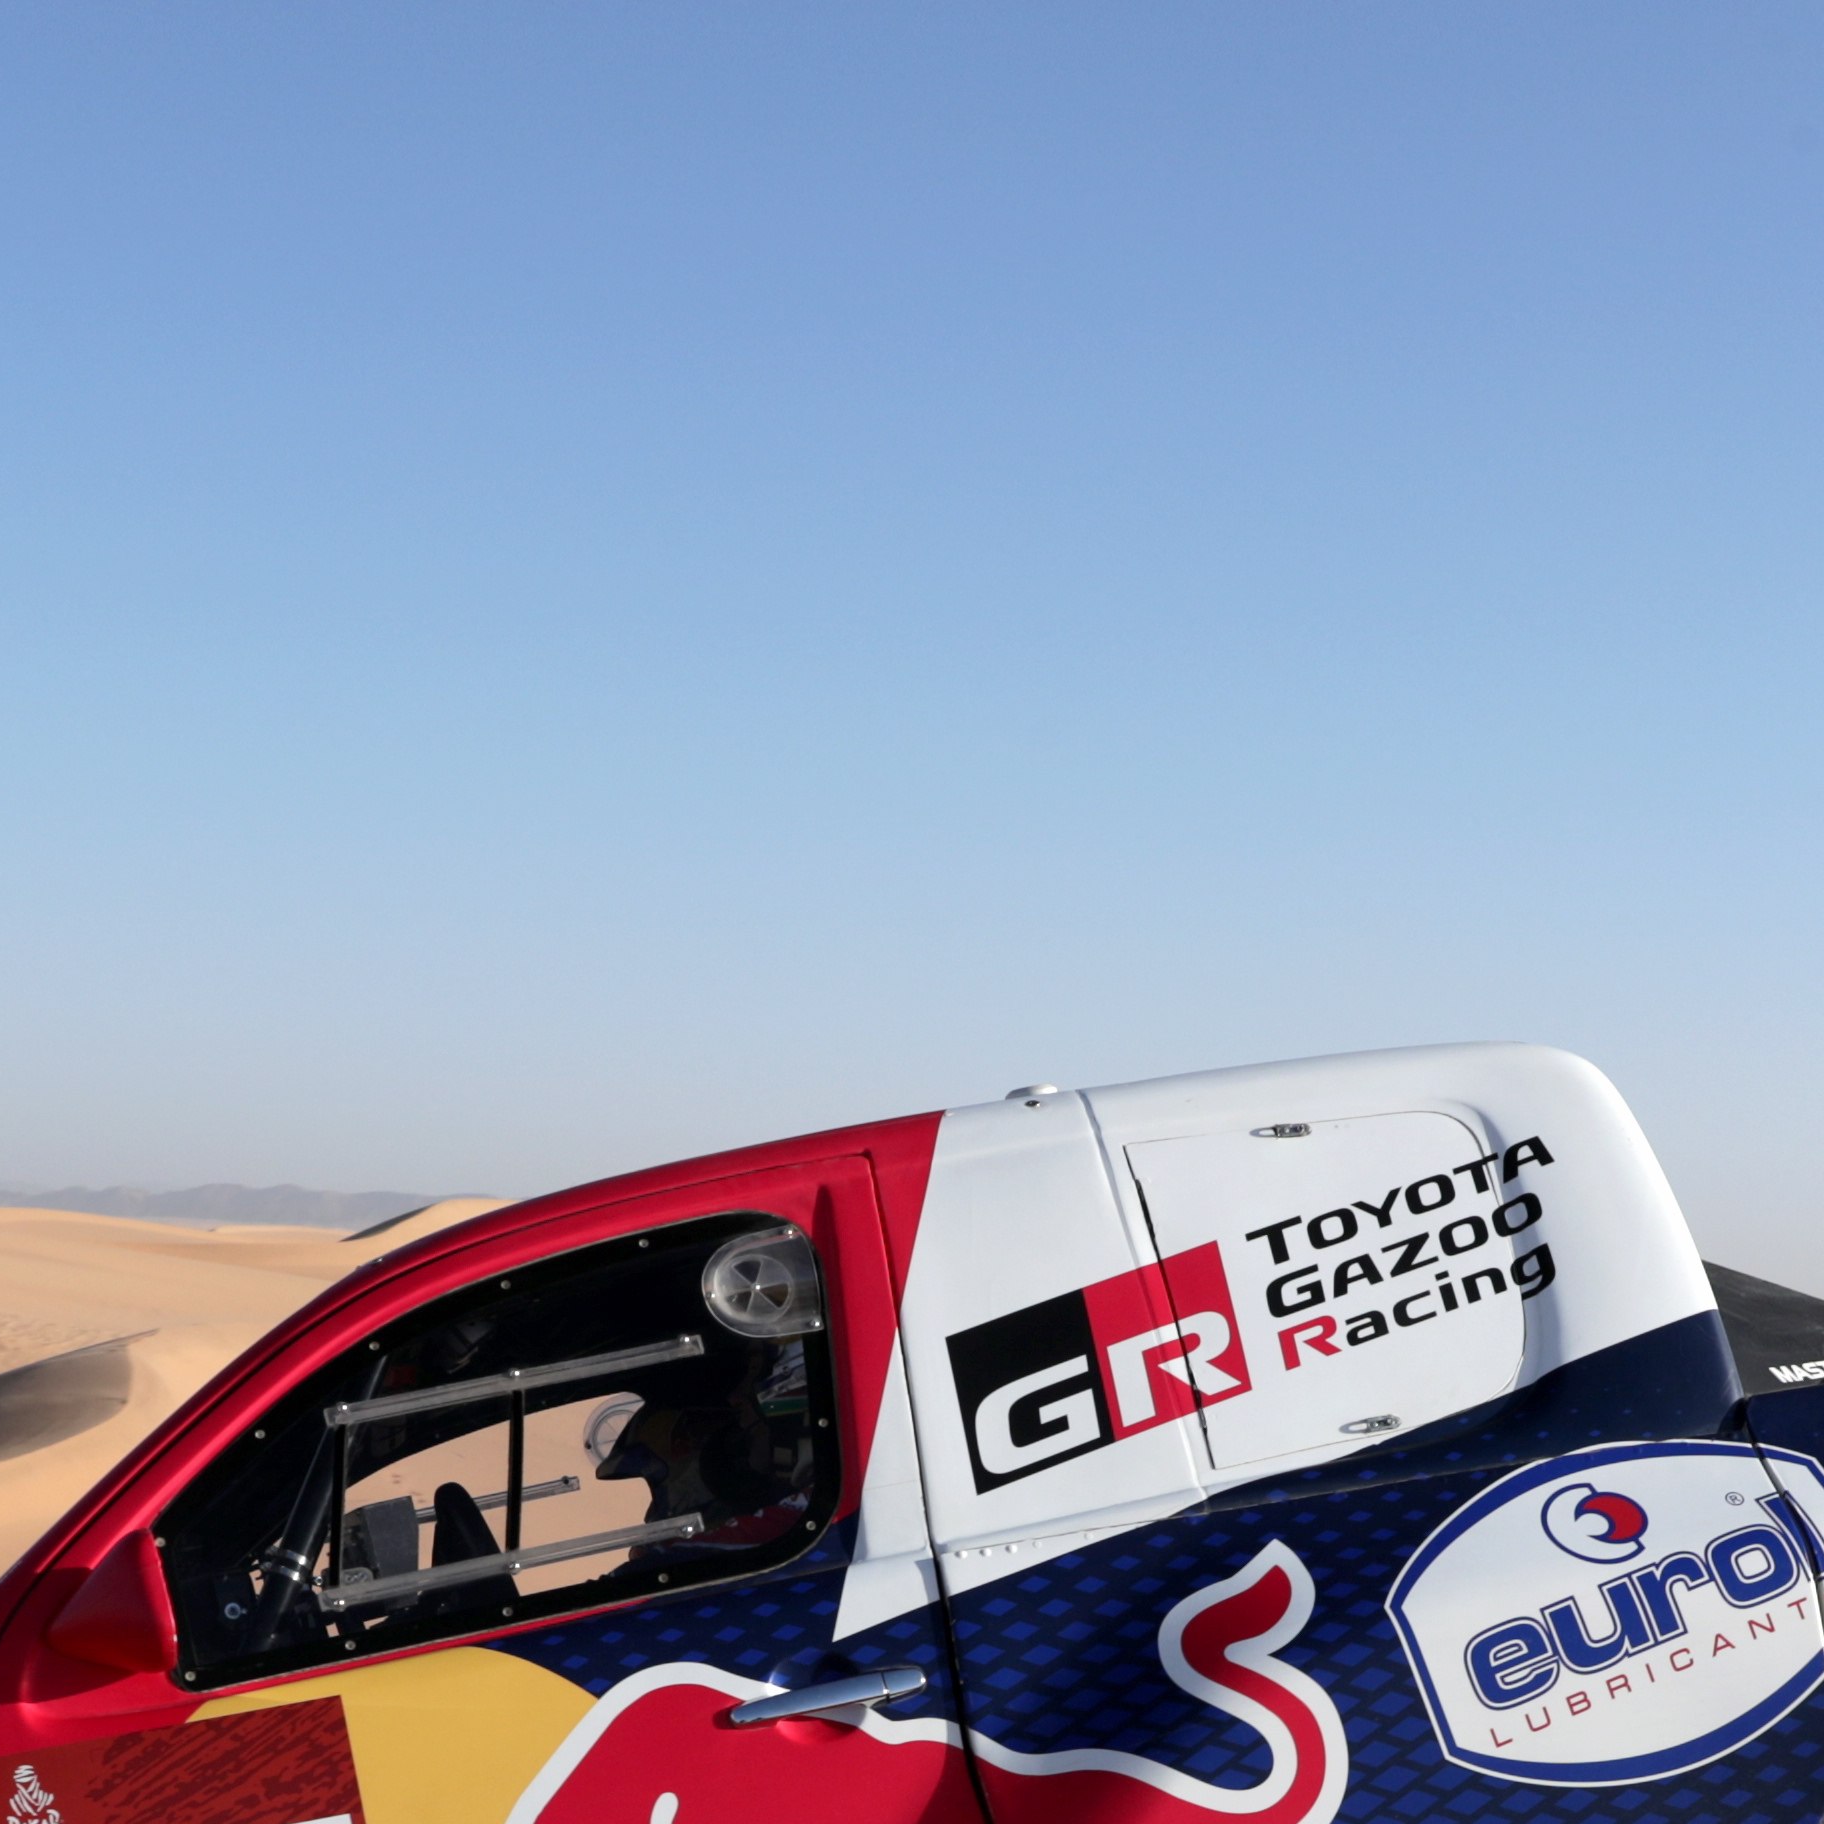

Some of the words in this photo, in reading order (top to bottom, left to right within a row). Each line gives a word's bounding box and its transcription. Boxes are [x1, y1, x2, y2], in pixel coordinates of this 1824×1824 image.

[1245, 1135, 1556, 1266] TOYOTA
[1265, 1192, 1544, 1319] GAZOO
[1276, 1242, 1557, 1371] Racing
[975, 1309, 1243, 1476] GR
